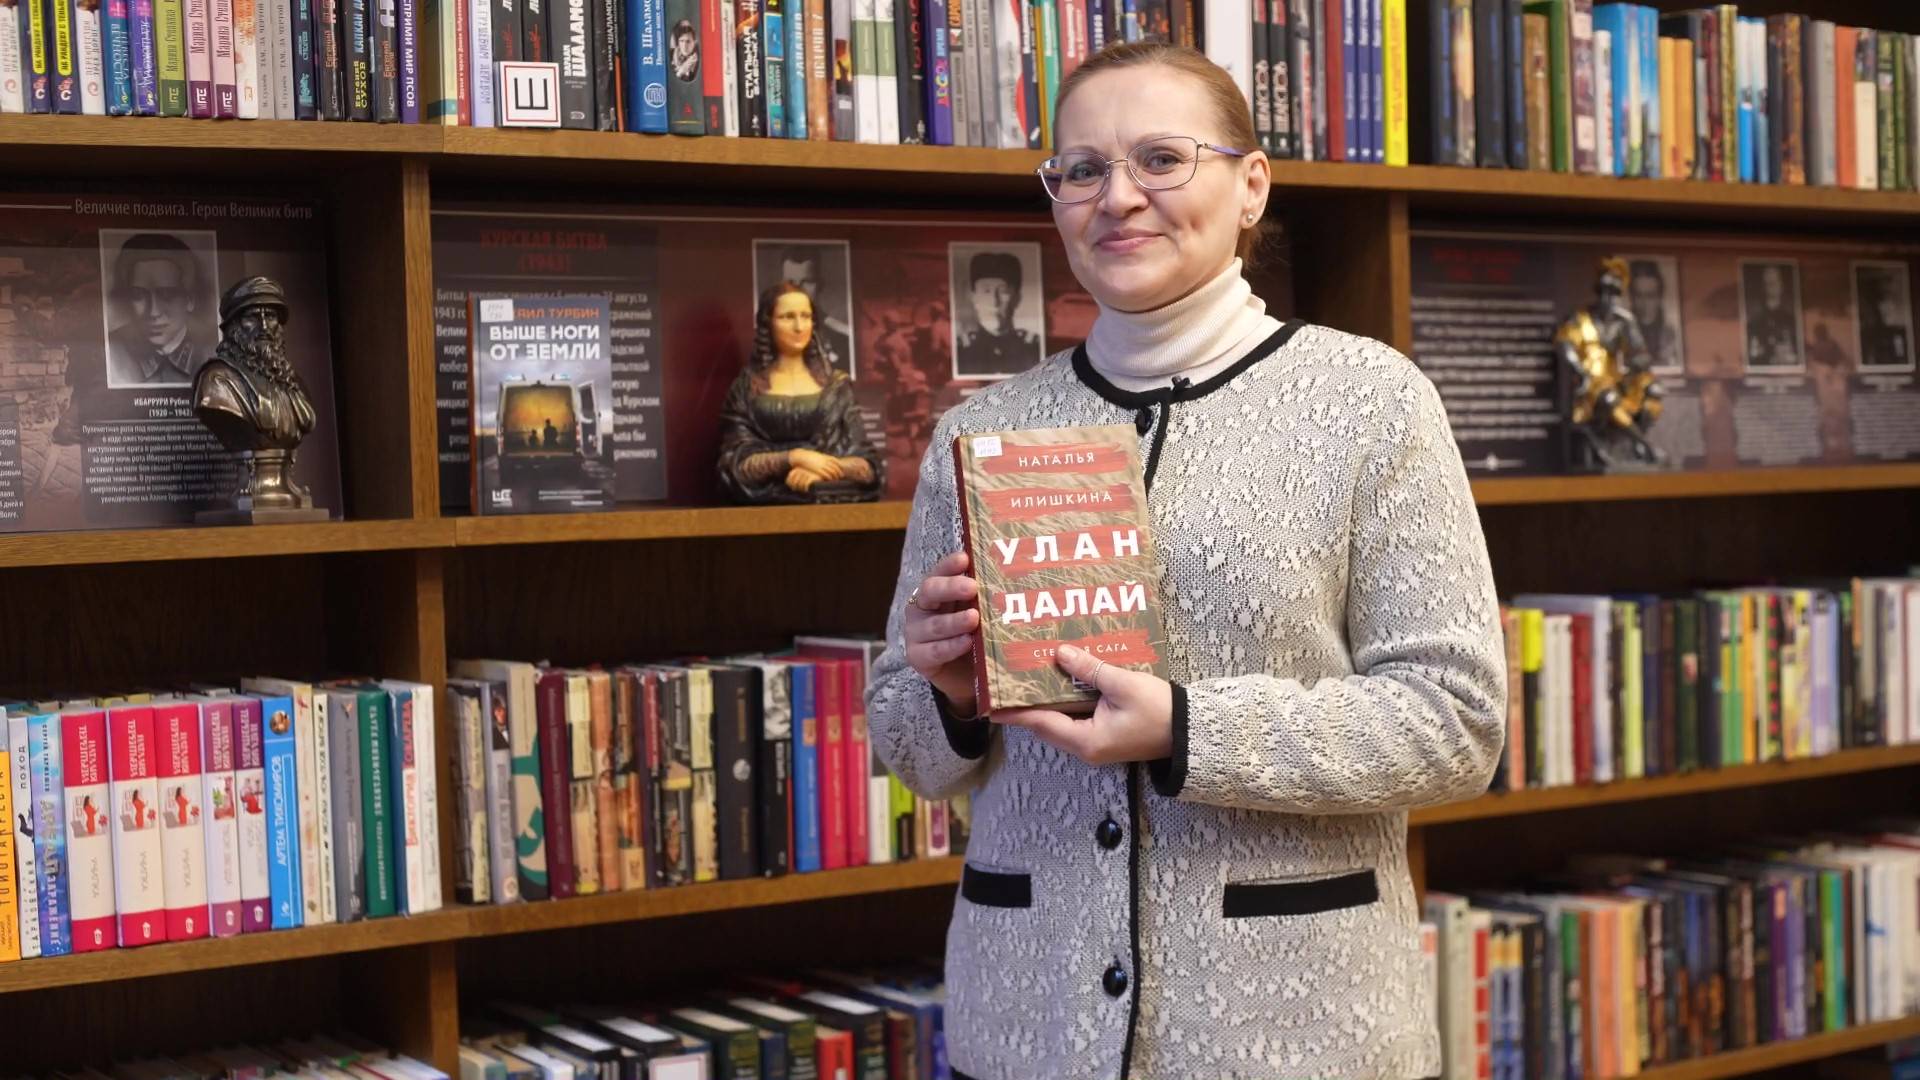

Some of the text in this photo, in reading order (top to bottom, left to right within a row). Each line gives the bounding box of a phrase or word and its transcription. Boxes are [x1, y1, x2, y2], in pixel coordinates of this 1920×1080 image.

[277, 5, 285, 34] ЧЕРТОЙ
[353, 13, 364, 53] КАПКАН
[190, 21, 206, 54] Марина
[216, 25, 232, 58] Марина
[405, 48, 413, 74] МИР
[563, 44, 571, 77] ВАРЛАМ
[643, 52, 654, 65] В.
[743, 25, 755, 99] СТАЛЬНАЯ
[752, 31, 760, 96] БАБОЧКА
[360, 61, 368, 108] СУХОВ
[406, 76, 414, 107] ПСОВ
[480, 64, 491, 104] ДЕРЕВОМ
[513, 77, 549, 110] Ш
[75, 199, 313, 220] Величие подвига. Герои Великих битв
[480, 231, 608, 250] КУРСКАЯ БИТВА
[435, 307, 455, 319] 1943
[549, 307, 600, 319] ТУРБИН
[489, 324, 600, 341] ВЫШЕ НОГИ
[490, 343, 600, 361] ОТ ЗЕМЛИ
[134, 397, 190, 408] ИБАРРУРИ Рубен
[1018, 452, 1096, 468] НАТАЛЬЯ
[1010, 492, 1113, 509] ИЛИШКИНА
[992, 529, 1142, 566] УЛАН
[1000, 580, 1148, 625] ДАЛАЙ
[1033, 641, 1129, 659] СТЕЯ САГА
[78, 726, 90, 784] ТЕРЕНТЬЕВА
[127, 720, 139, 778] ТЕРЕНТЬЕВА
[170, 718, 182, 776] ТЕРЕНТЬЕВА
[210, 711, 222, 771] ТЕРЕНТЬЕВА
[239, 708, 251, 769] ТЕРЕНТЬЕВА
[18, 746, 26, 789] ПОХОД
[271, 755, 288, 866] АРТЕМ ТИХОМИРОВ
[26, 859, 39, 949] ТАРКОВСКИЙ
[45, 876, 60, 946] ЗАРАЖЕНИЕ
